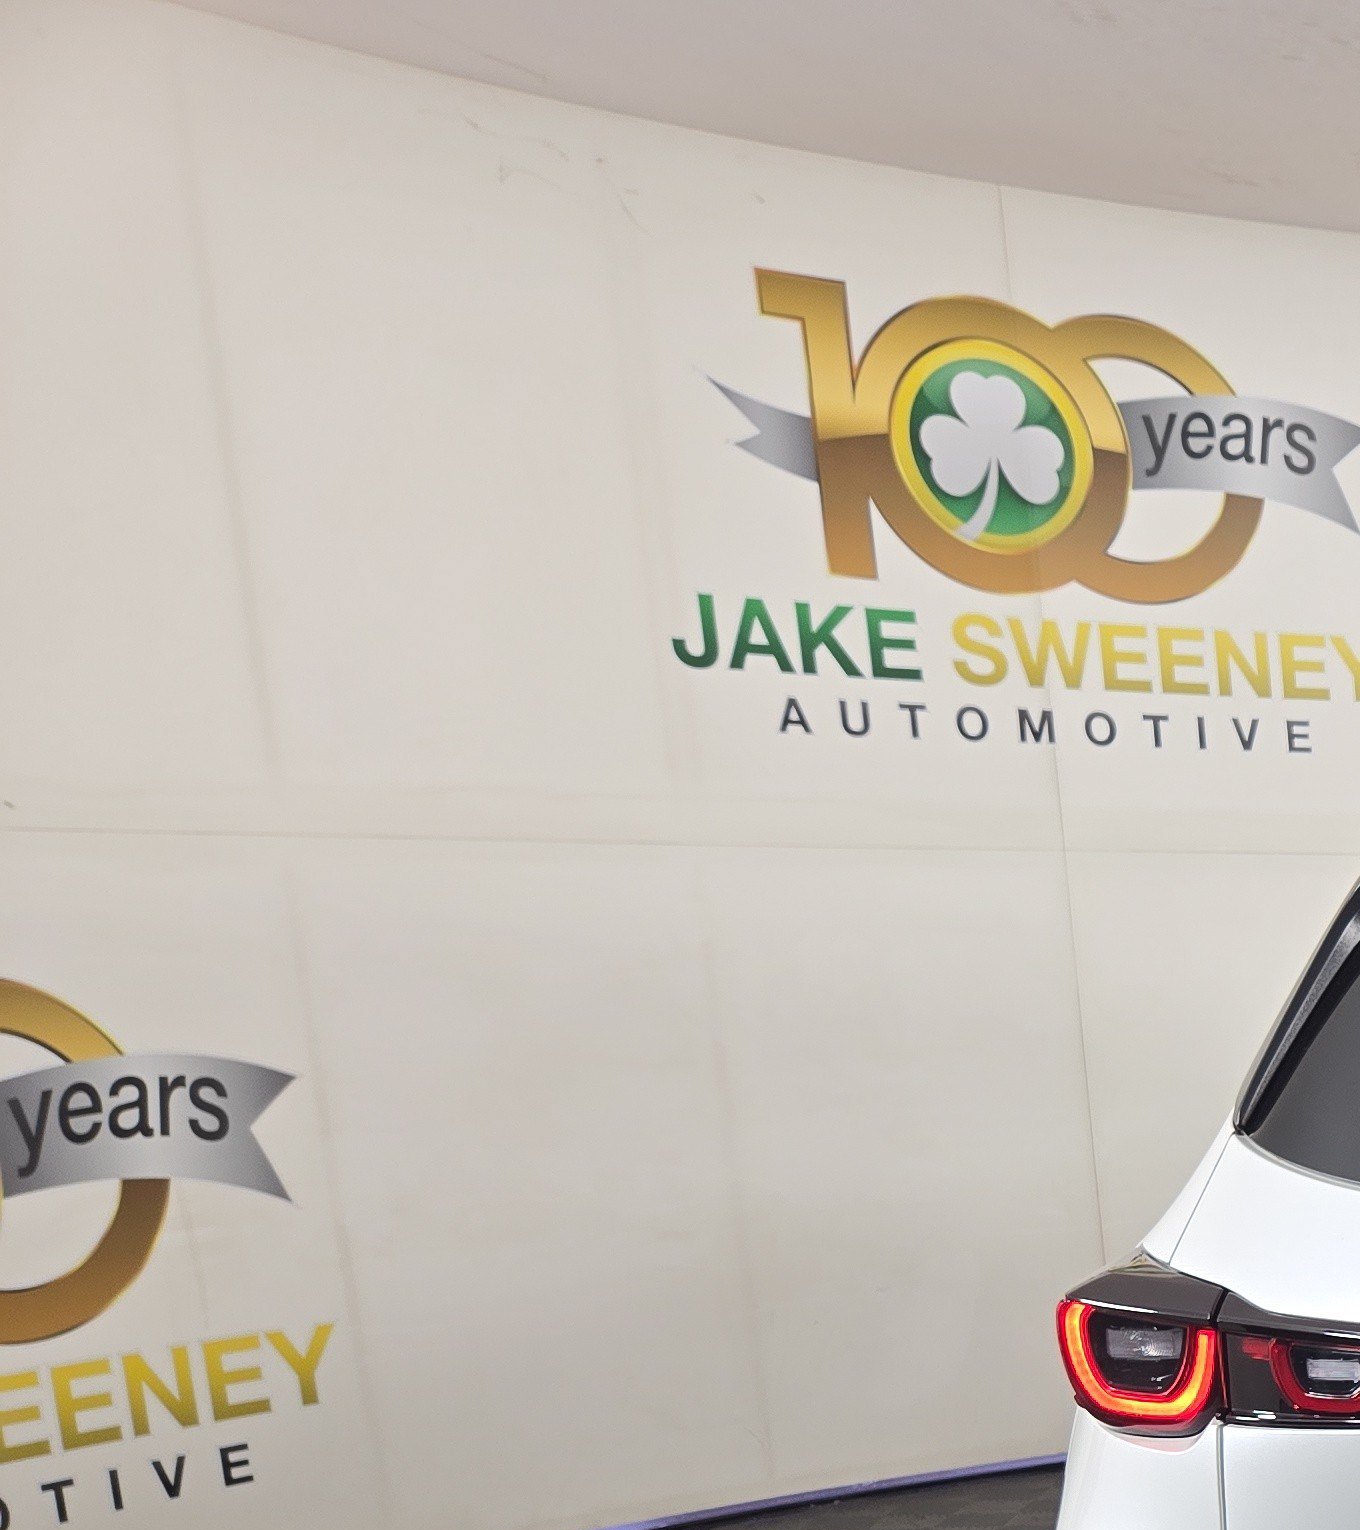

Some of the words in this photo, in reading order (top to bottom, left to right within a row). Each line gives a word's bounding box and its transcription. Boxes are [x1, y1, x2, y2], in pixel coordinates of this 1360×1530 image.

[754, 266, 1265, 605] 100
[1141, 404, 1318, 477] years
[670, 593, 924, 683] JAKE
[779, 697, 1314, 753] AUTOMOTIVE
[9, 1075, 231, 1179] years
